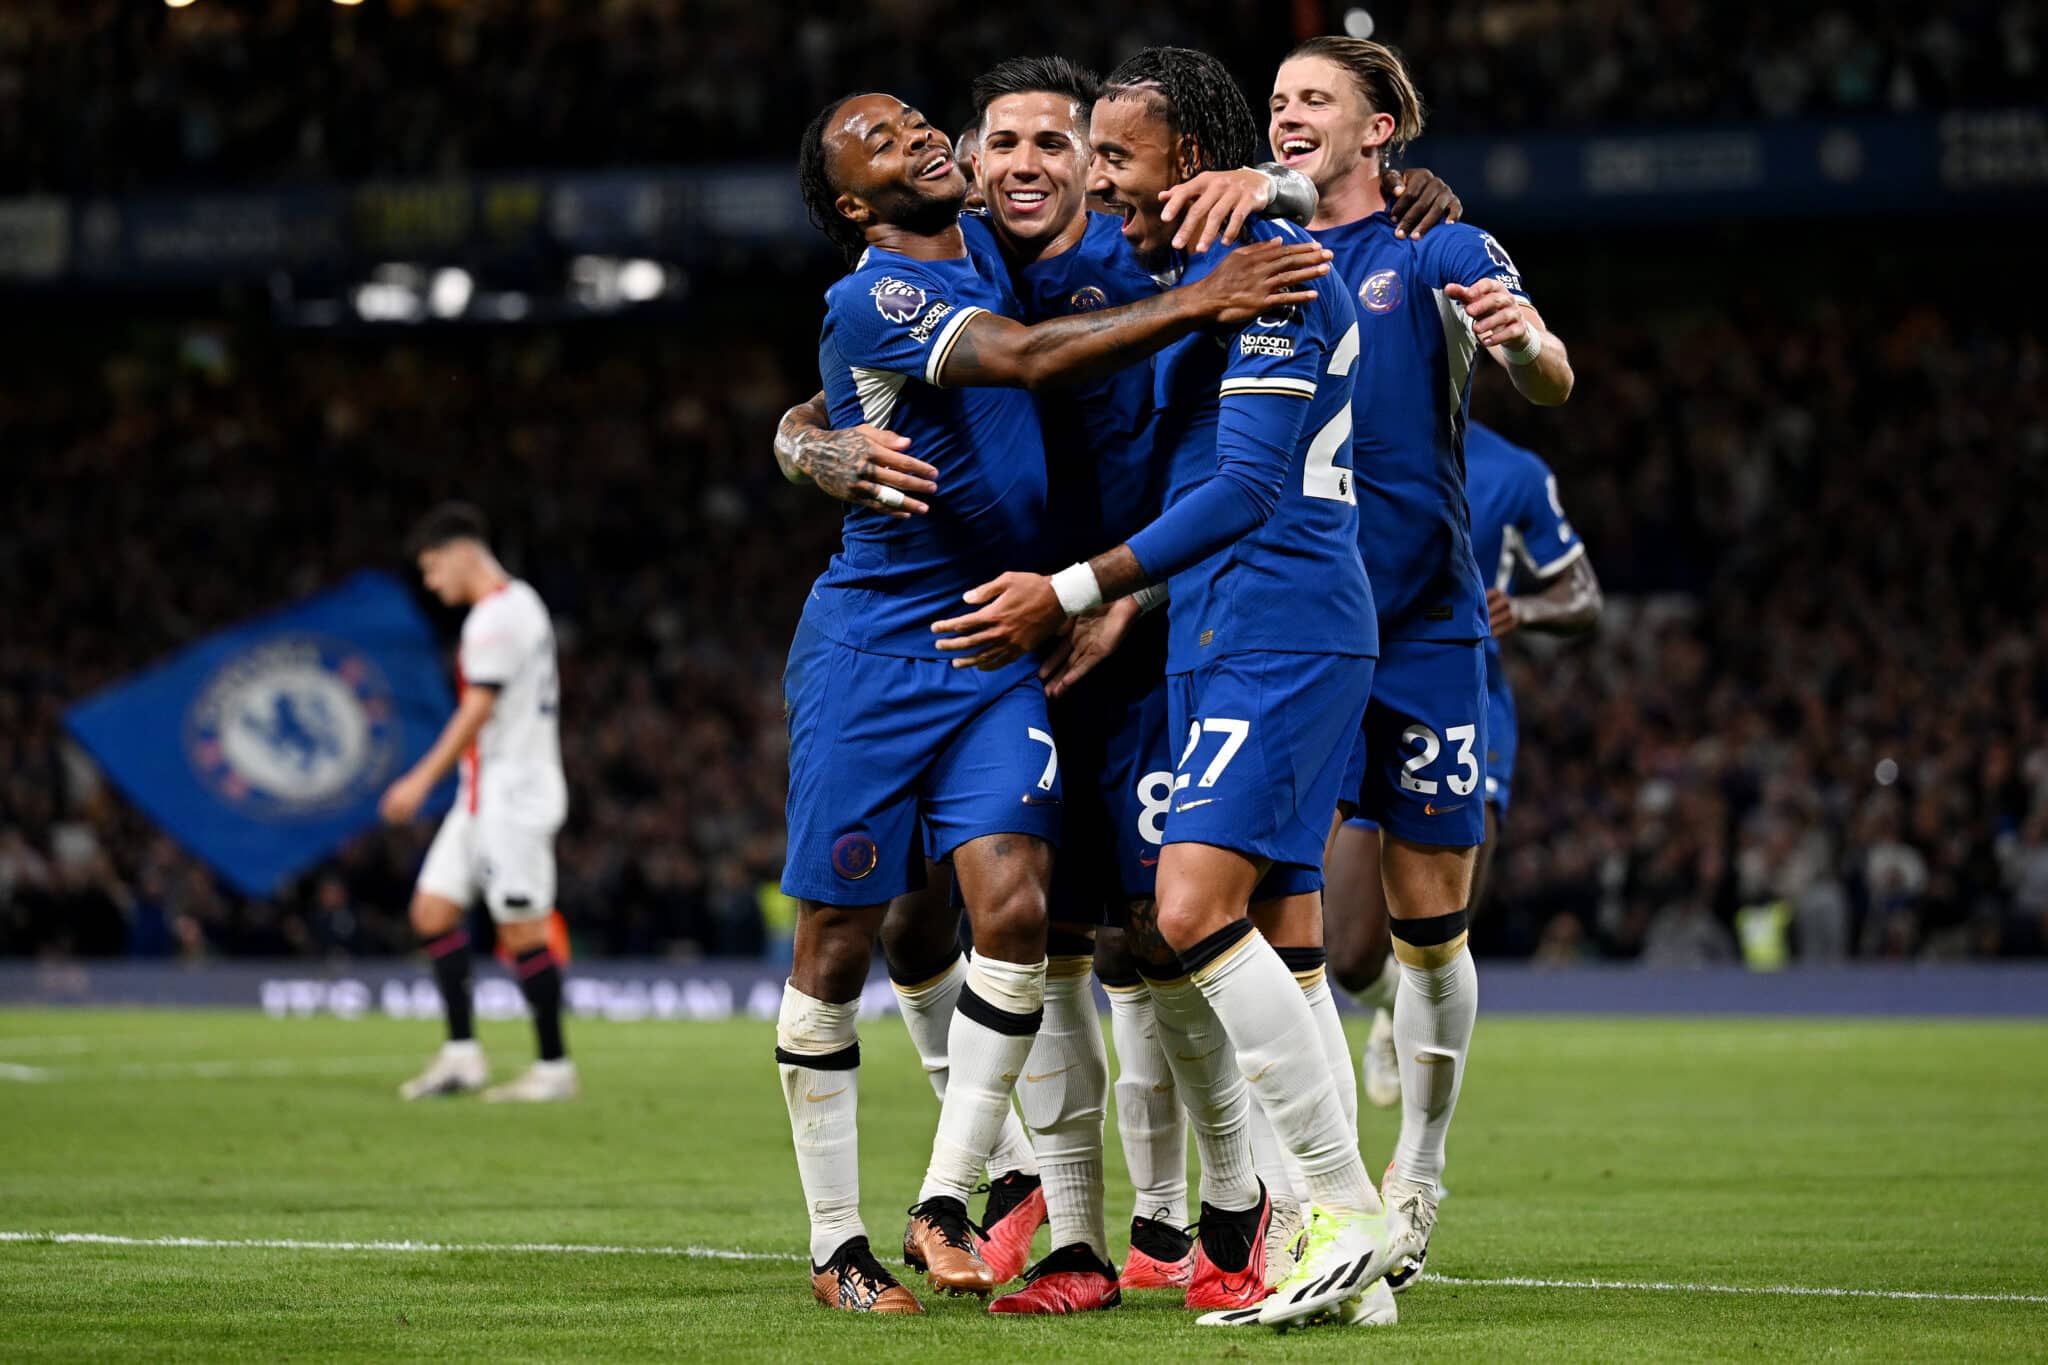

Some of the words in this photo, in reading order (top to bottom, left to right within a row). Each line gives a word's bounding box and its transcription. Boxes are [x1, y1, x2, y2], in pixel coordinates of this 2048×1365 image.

[921, 302, 947, 328] room
[1241, 334, 1256, 345] No
[1257, 335, 1290, 348] room
[1254, 345, 1294, 357] racism
[1028, 727, 1058, 791] 7
[1174, 718, 1250, 791] 27
[1401, 724, 1479, 796] 23
[1137, 771, 1174, 845] 8
